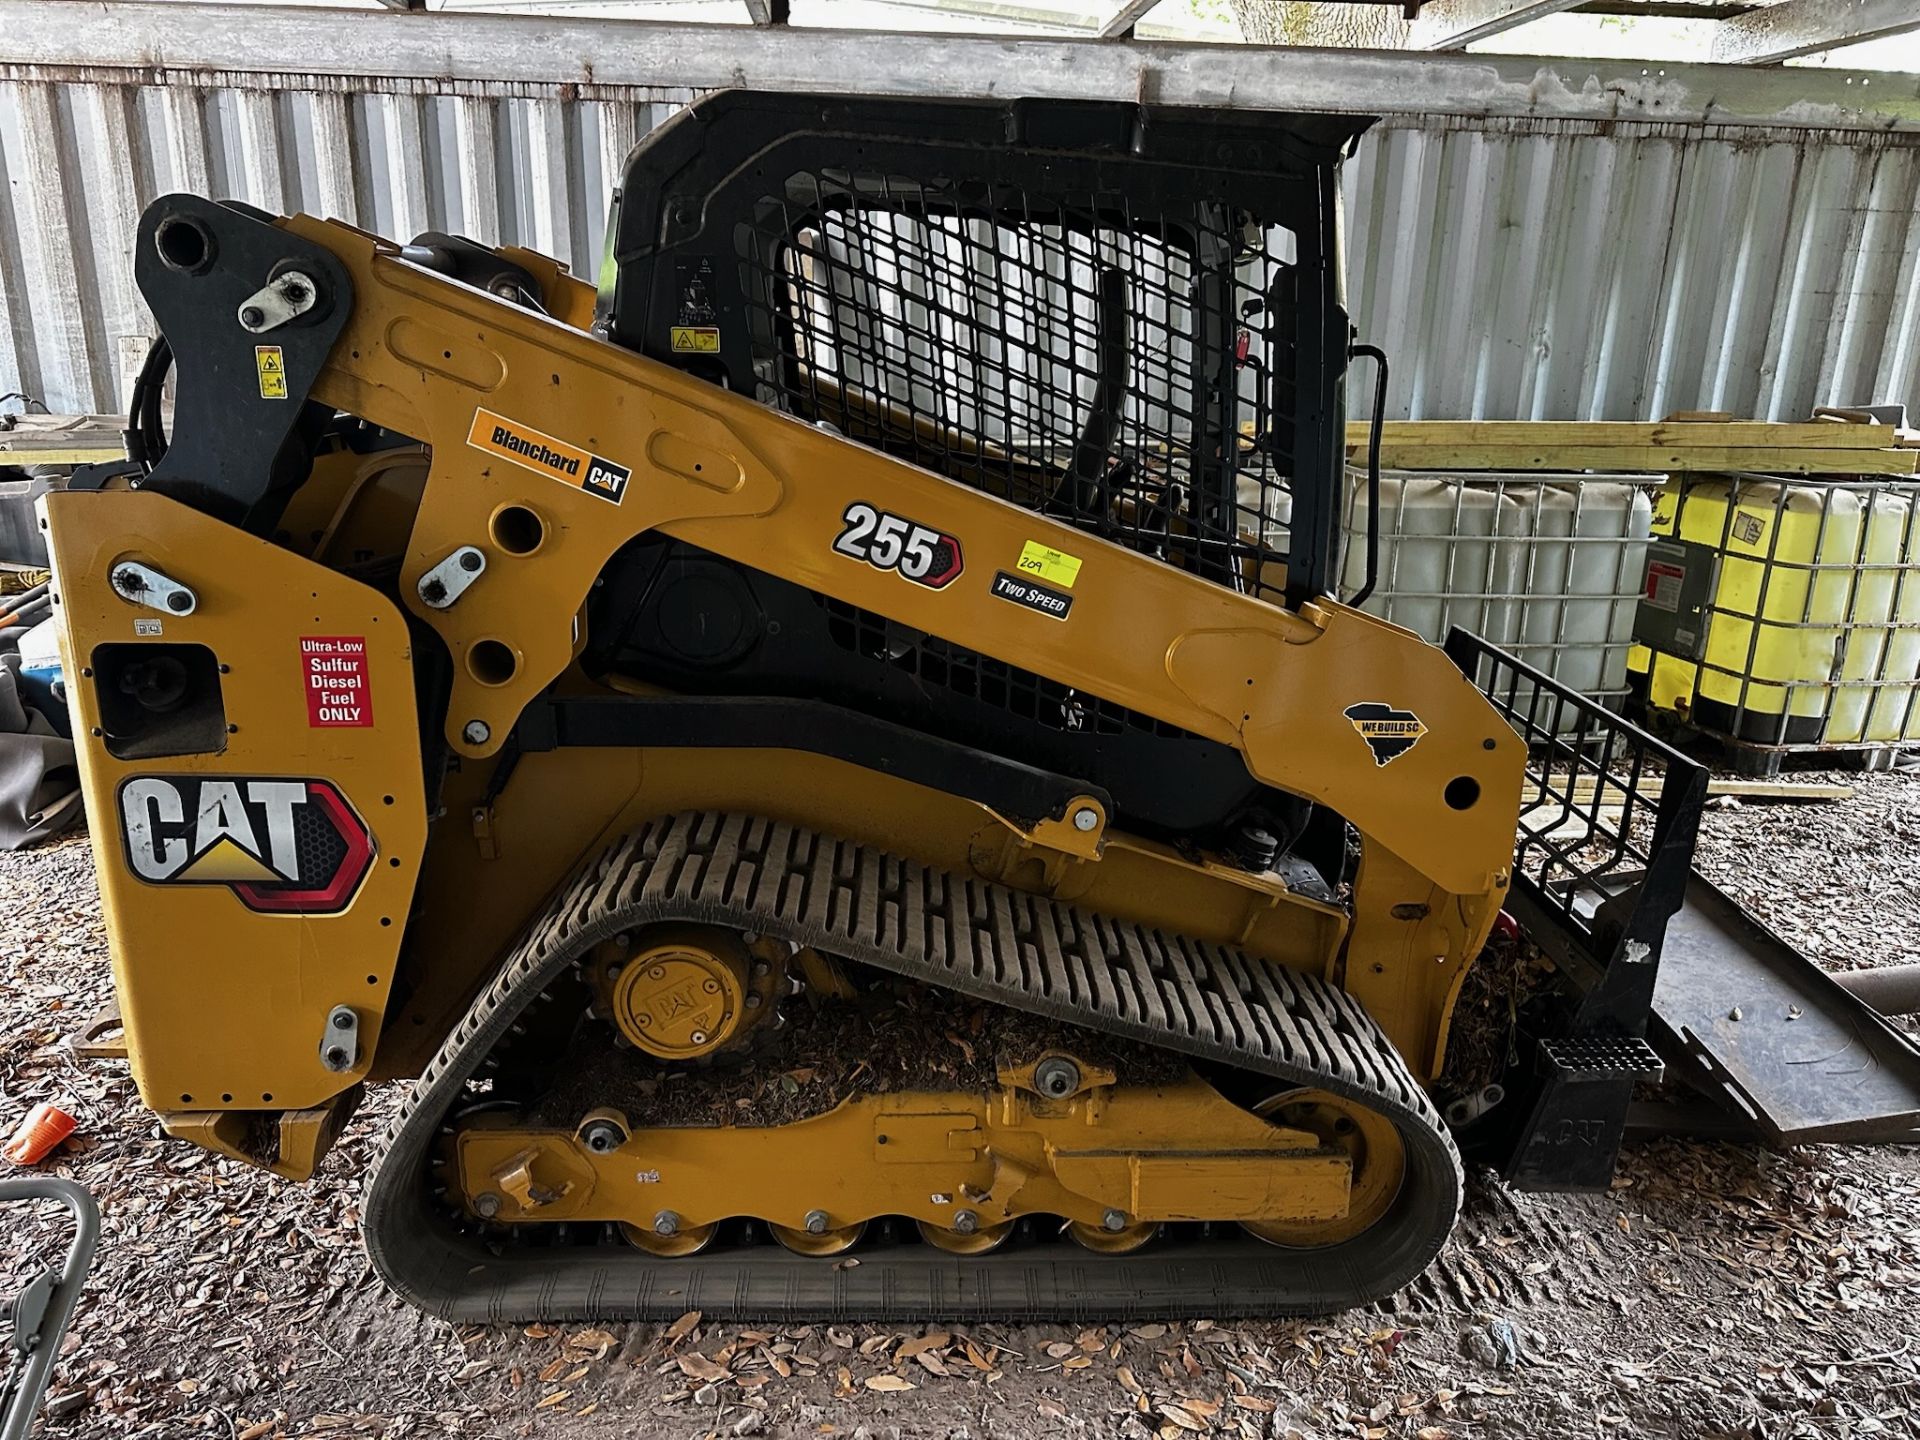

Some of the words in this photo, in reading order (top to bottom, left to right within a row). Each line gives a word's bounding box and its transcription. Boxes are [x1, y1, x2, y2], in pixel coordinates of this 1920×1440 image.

[491, 425, 581, 476] Blanchard
[589, 466, 623, 493] CAT
[836, 505, 940, 577] 255
[1020, 557, 1042, 573] 209
[997, 578, 1026, 597] TWO
[1026, 589, 1066, 612] SPEED
[302, 640, 363, 652] Ultra-Low
[310, 657, 359, 672] Sulfur
[310, 674, 362, 689] Diesel
[321, 691, 355, 705] Fuel
[319, 707, 361, 721] ONLY
[1362, 722, 1377, 732] WE
[1377, 722, 1405, 732] BUILD
[1406, 722, 1419, 732] SC
[122, 778, 307, 881] CAT
